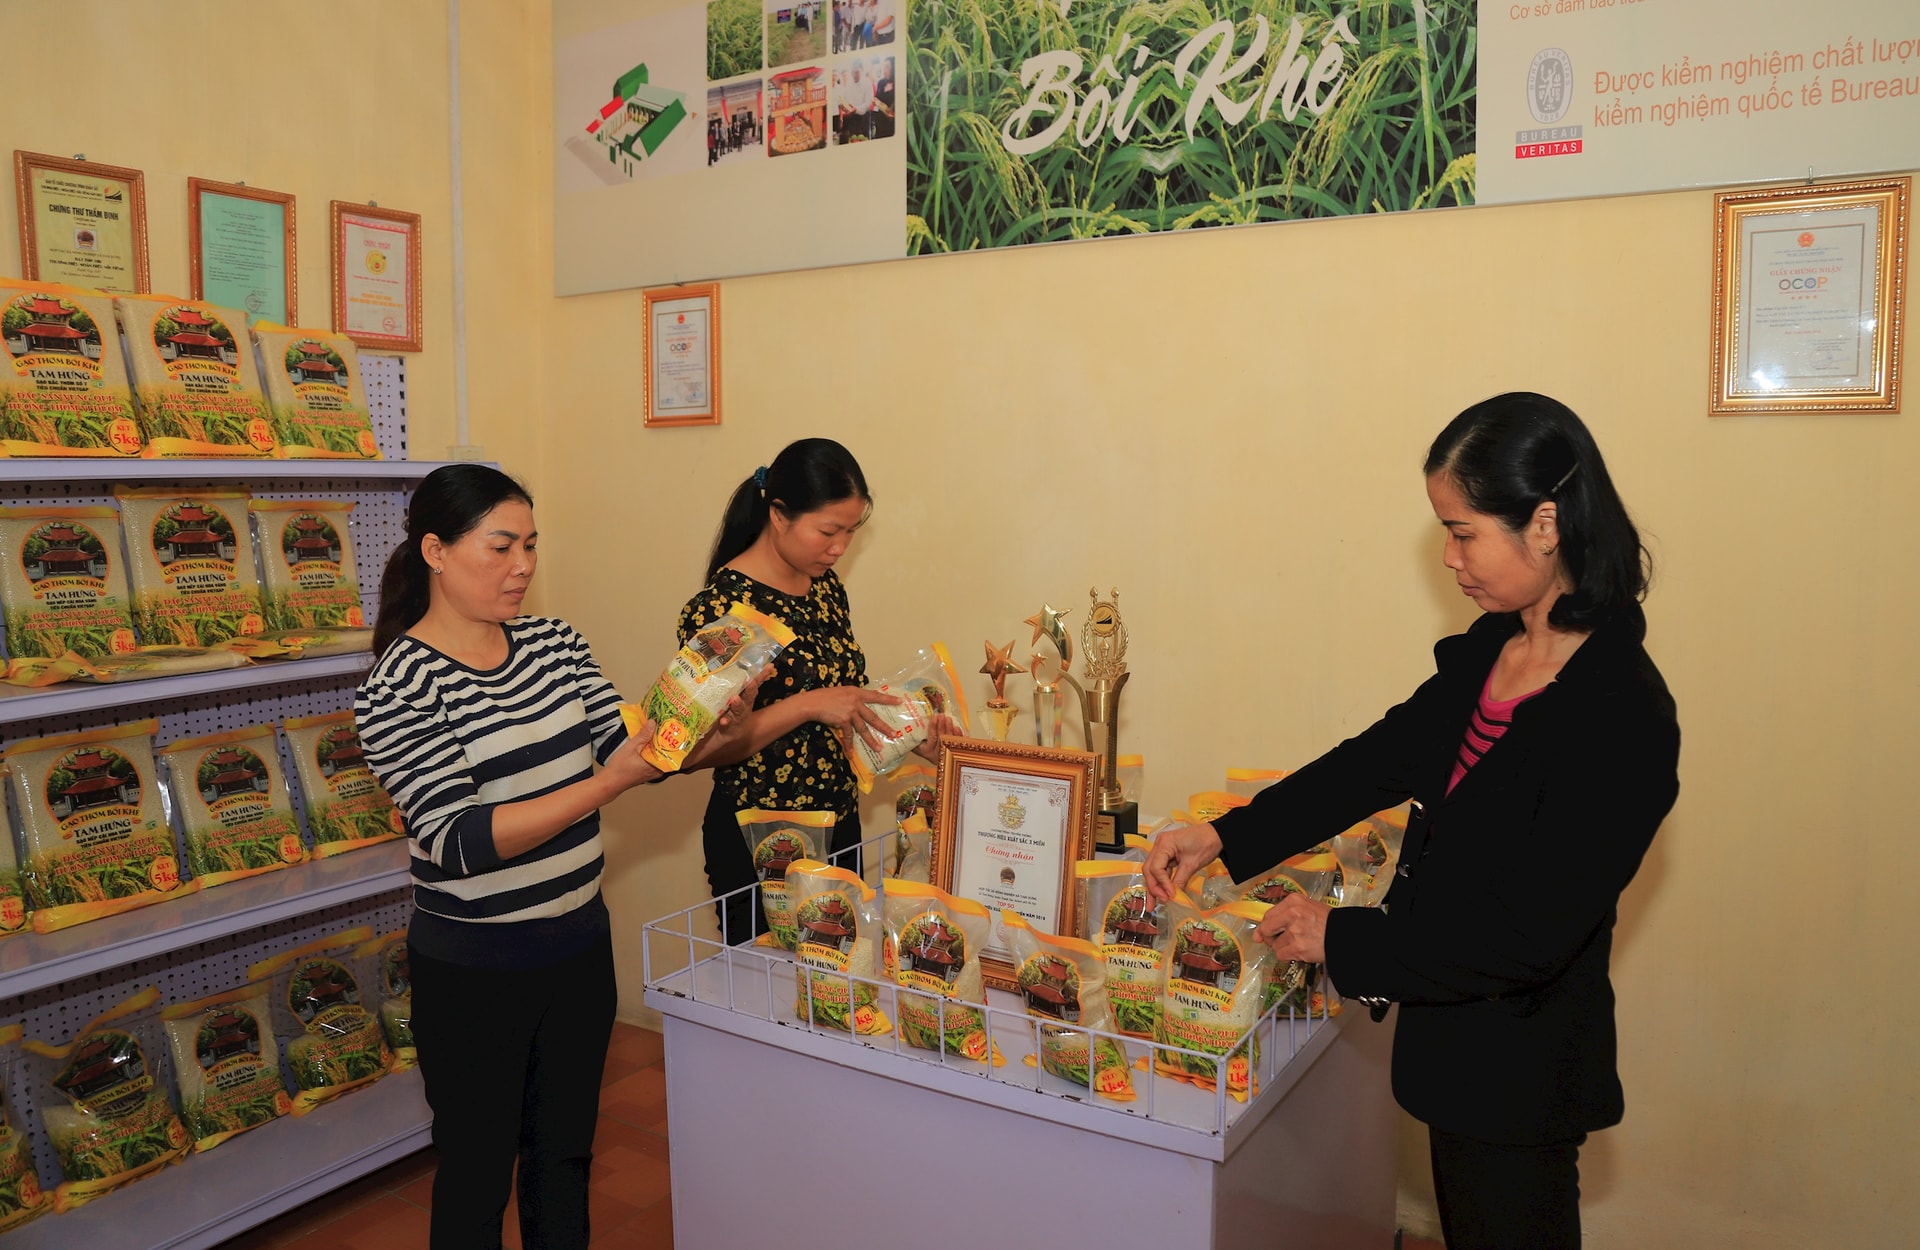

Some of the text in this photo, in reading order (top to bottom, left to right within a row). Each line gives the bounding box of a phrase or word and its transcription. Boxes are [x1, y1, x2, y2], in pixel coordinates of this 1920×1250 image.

[1510, 5, 1530, 20] Cơ
[1594, 35, 1920, 95] Được kiểm nghiệm chất lượ
[1002, 13, 1360, 155] Bối Khê
[1594, 75, 1920, 127] kiểm nghiệm quốc tế Bureau
[1521, 127, 1577, 142] BUREAU
[1521, 142, 1577, 156] VERITAS
[1779, 276, 1828, 290] OCOP
[30, 370, 56, 379] TAM
[179, 374, 201, 382] TAM
[114, 434, 140, 447] 5kg
[176, 576, 196, 584] TAM
[45, 592, 67, 600] TAM
[115, 641, 134, 652] 3kg
[661, 729, 680, 749] 1kg
[220, 810, 239, 818] TAM
[74, 819, 131, 838] TAM HƯNG
[284, 847, 300, 855] 3kg
[155, 869, 178, 885] 5kg
[1, 909, 23, 920] 3kg
[801, 956, 814, 966] TAM
[1108, 956, 1125, 967] TAM
[1174, 993, 1190, 1004] TAM
[855, 1014, 872, 1025] kg
[1101, 1081, 1126, 1092] 1kg
